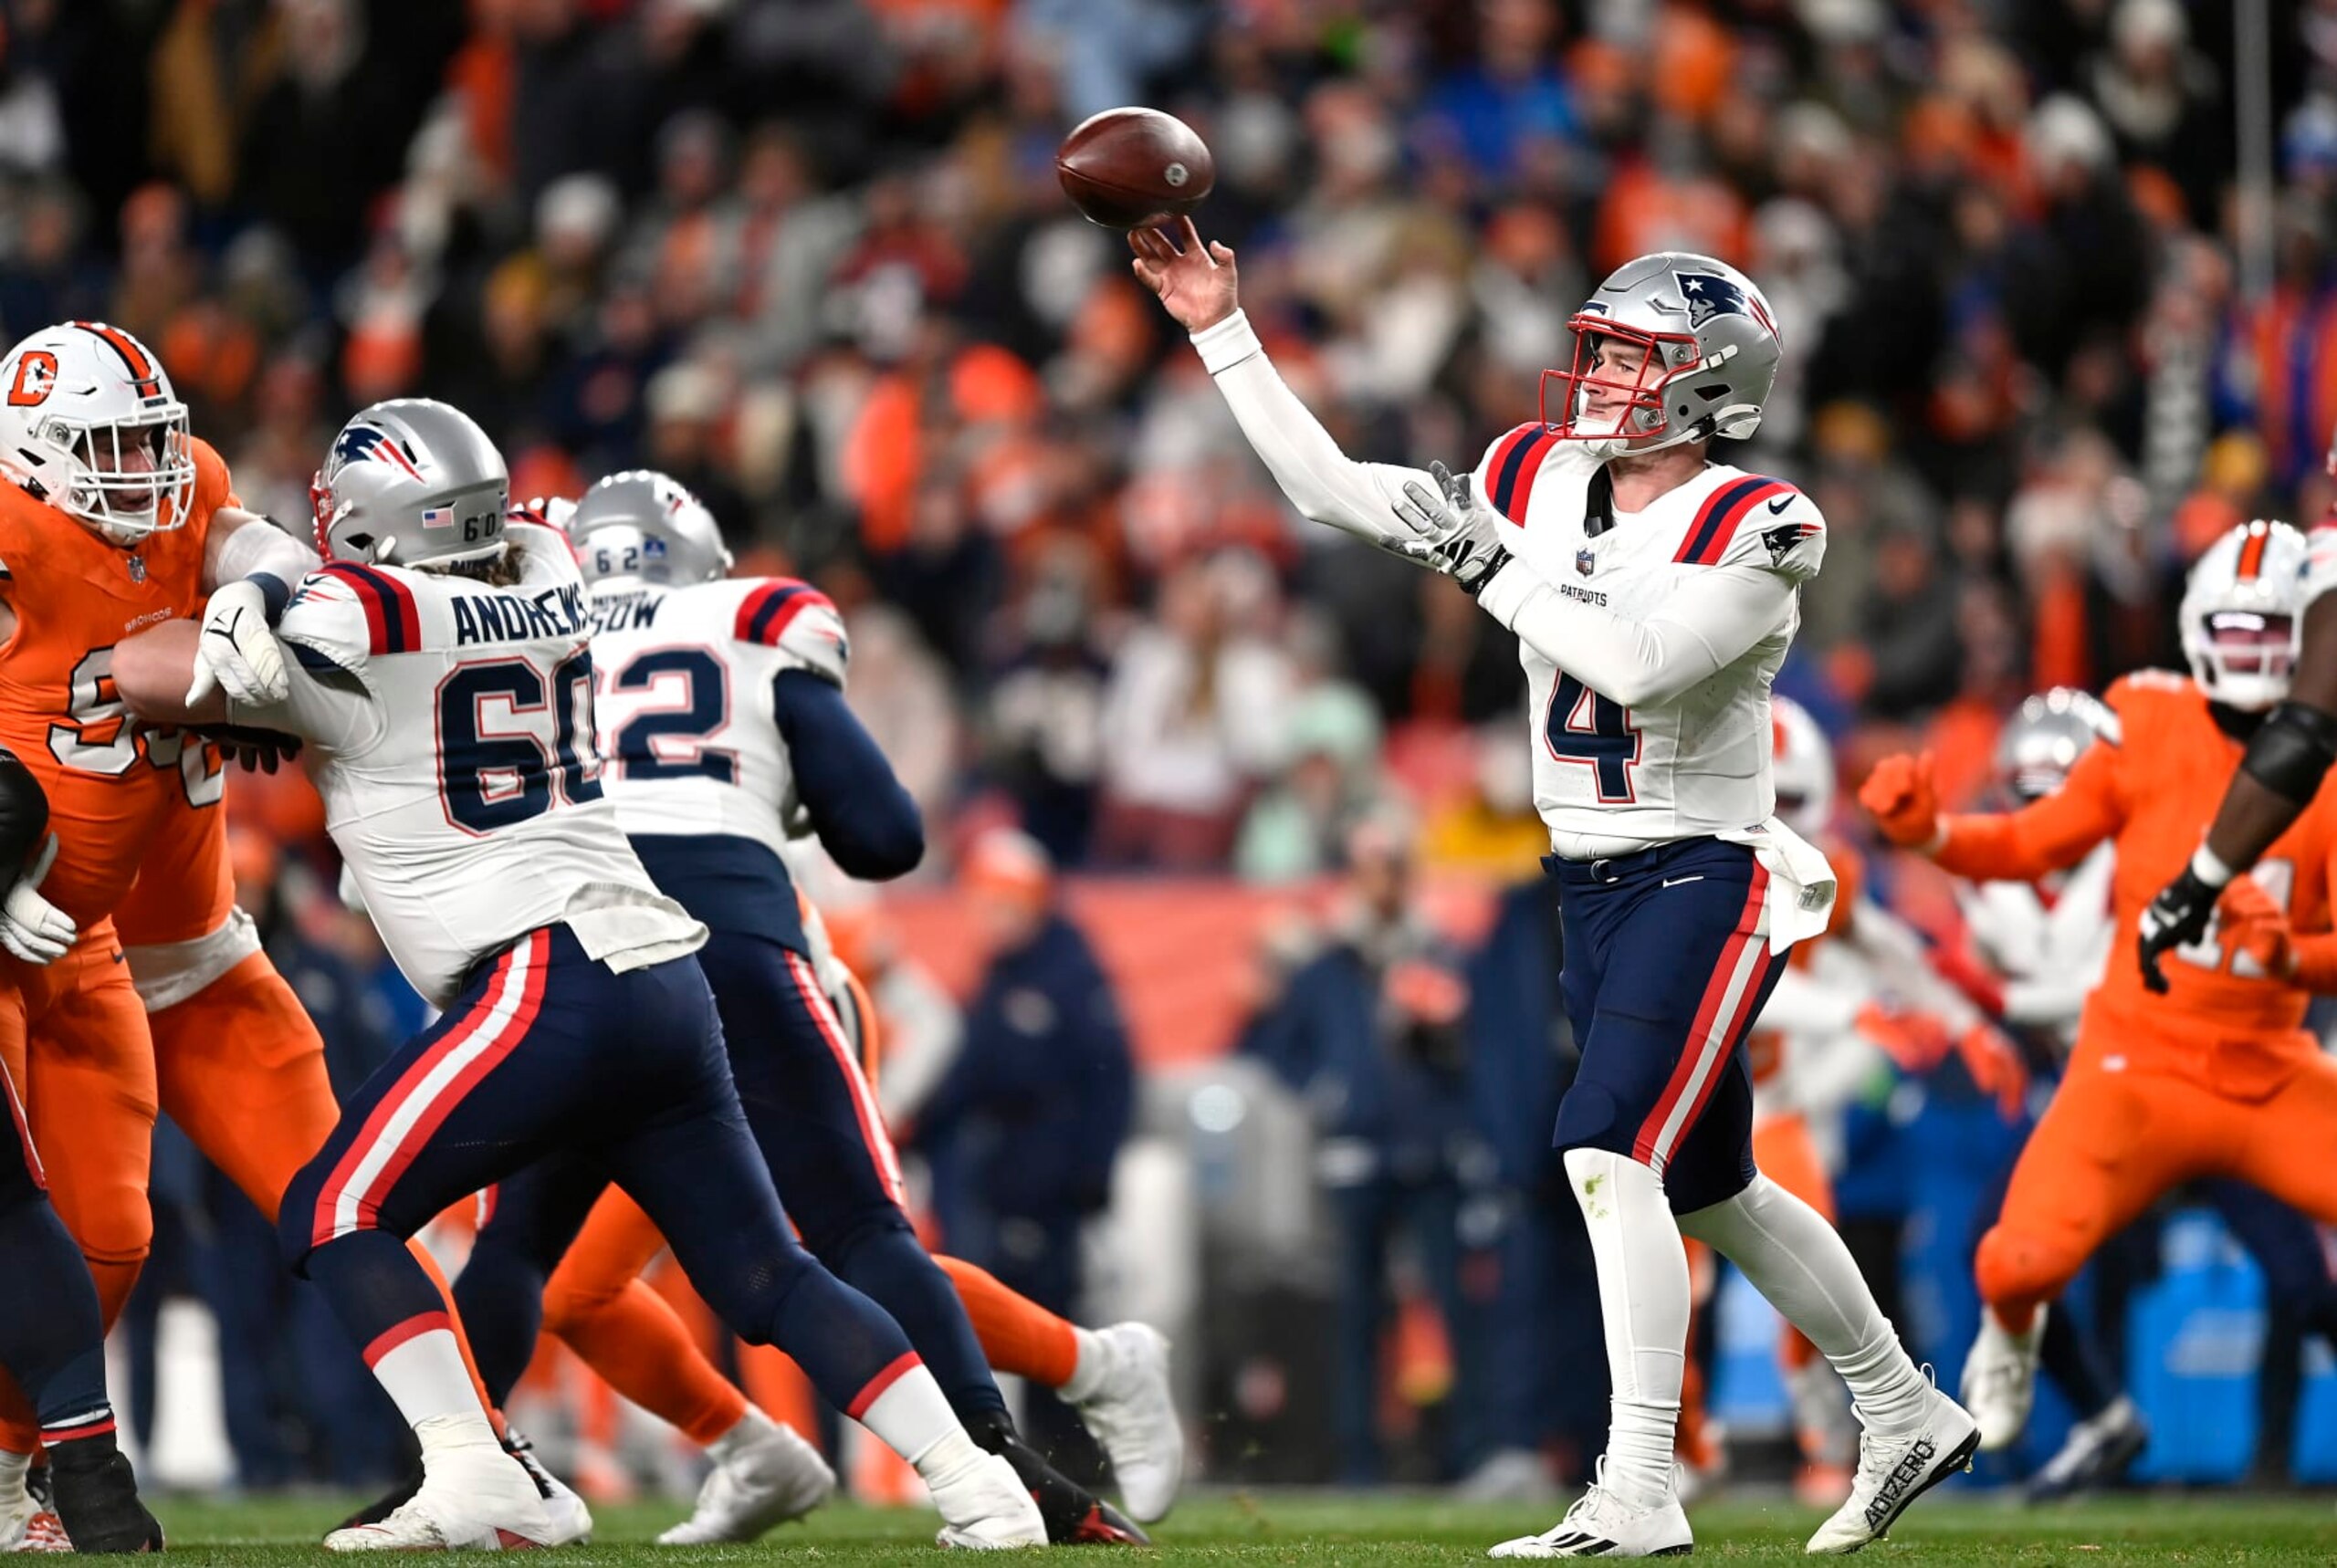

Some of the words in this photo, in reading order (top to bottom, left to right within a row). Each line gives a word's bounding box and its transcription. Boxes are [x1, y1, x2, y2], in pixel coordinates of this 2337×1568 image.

[464, 513, 496, 541] 60
[596, 547, 638, 573] 62
[124, 606, 173, 632] BRONCOS
[451, 581, 588, 646] ANDREWS
[1560, 583, 1608, 607] PATRIOTS
[47, 644, 182, 778] 9
[435, 639, 604, 838] 60
[592, 643, 740, 787] 2
[1544, 668, 1641, 804] 4
[1864, 1438, 1936, 1532] ADIZERO
